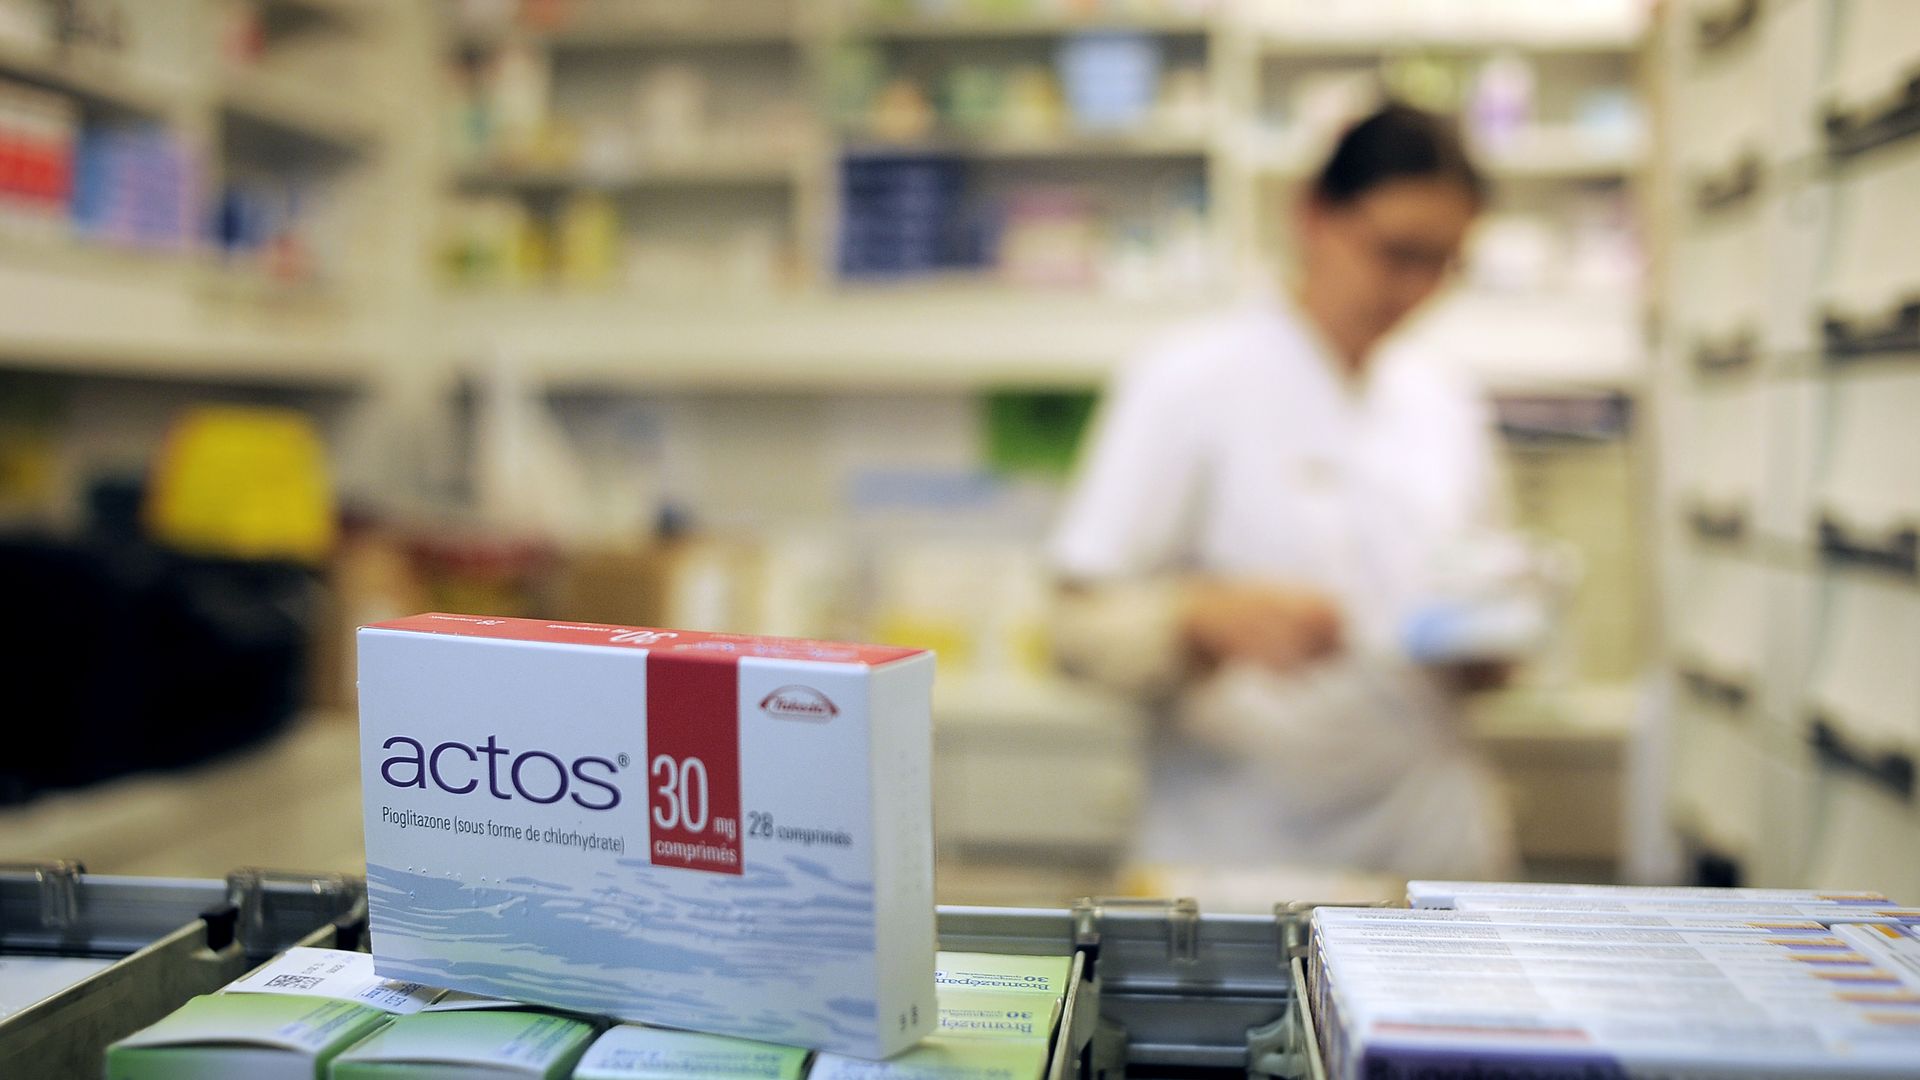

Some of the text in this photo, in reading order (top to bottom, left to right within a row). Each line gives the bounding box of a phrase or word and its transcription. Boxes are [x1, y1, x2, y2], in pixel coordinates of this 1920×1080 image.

[652, 754, 737, 840] 30 mg
[382, 806, 625, 855] Pioglitazone (sous forme de chlorhydrate)
[748, 810, 853, 848] 28 comprimés
[655, 839, 738, 864] comprimés
